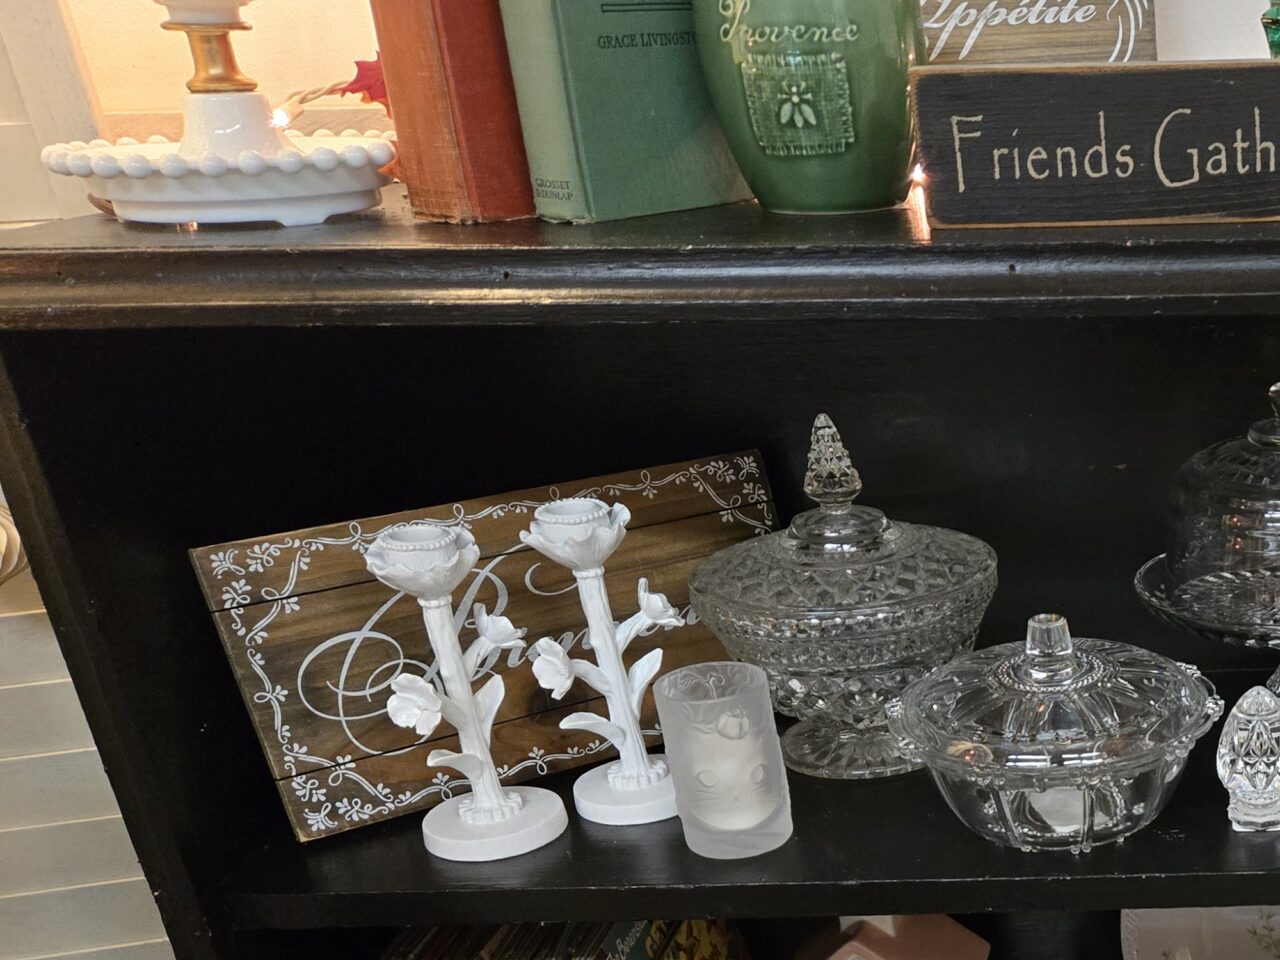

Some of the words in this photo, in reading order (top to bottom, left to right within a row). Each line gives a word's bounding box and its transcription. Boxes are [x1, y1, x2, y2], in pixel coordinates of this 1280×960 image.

[598, 32, 638, 49] GRACE
[718, 0, 860, 43] Provence
[950, 111, 1136, 193] Friends
